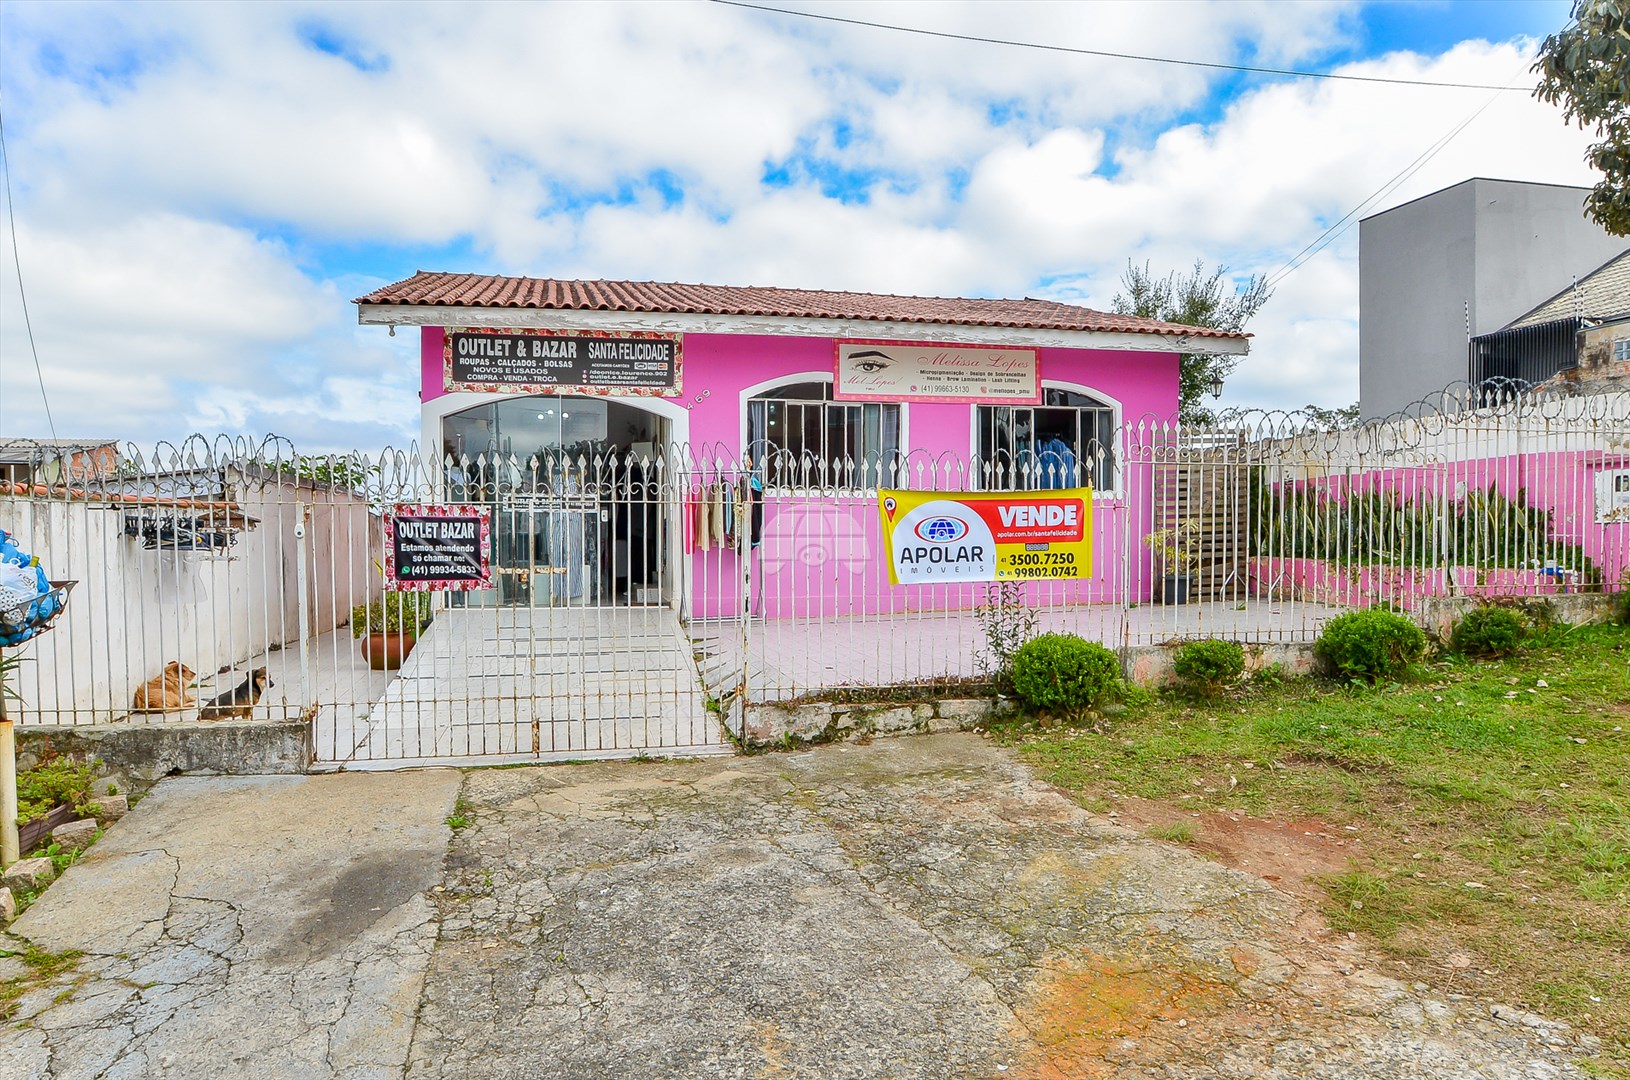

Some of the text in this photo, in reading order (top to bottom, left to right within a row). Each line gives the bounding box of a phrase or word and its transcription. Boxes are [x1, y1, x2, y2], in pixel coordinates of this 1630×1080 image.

[458, 337, 577, 358] OUTLET & BAZAR
[588, 342, 669, 360] SANTA FELICIDADE
[459, 357, 490, 365] ROUPAS
[497, 358, 536, 368] CALÇADOS
[544, 360, 573, 368] BOLSAS
[917, 352, 1029, 372] Melissa Lopes
[473, 366, 503, 374] NOVOS
[843, 374, 898, 388] Mel Lopes
[921, 385, 970, 394] (41) 99663-5130
[997, 505, 1077, 528] VENDE
[399, 521, 475, 538] OUTLET BAZAR
[997, 530, 1077, 538] apolar.com.br/santafelicidade
[401, 543, 474, 552] Estamos atendendo
[412, 554, 422, 562] só
[423, 554, 452, 562] chamar
[900, 546, 983, 564] APOLAR
[1009, 553, 1074, 565] 3500.7250
[412, 565, 476, 576] (41) 99934-5833
[900, 565, 984, 574] IMÓVEIS
[1015, 566, 1078, 578] 99802.0742
